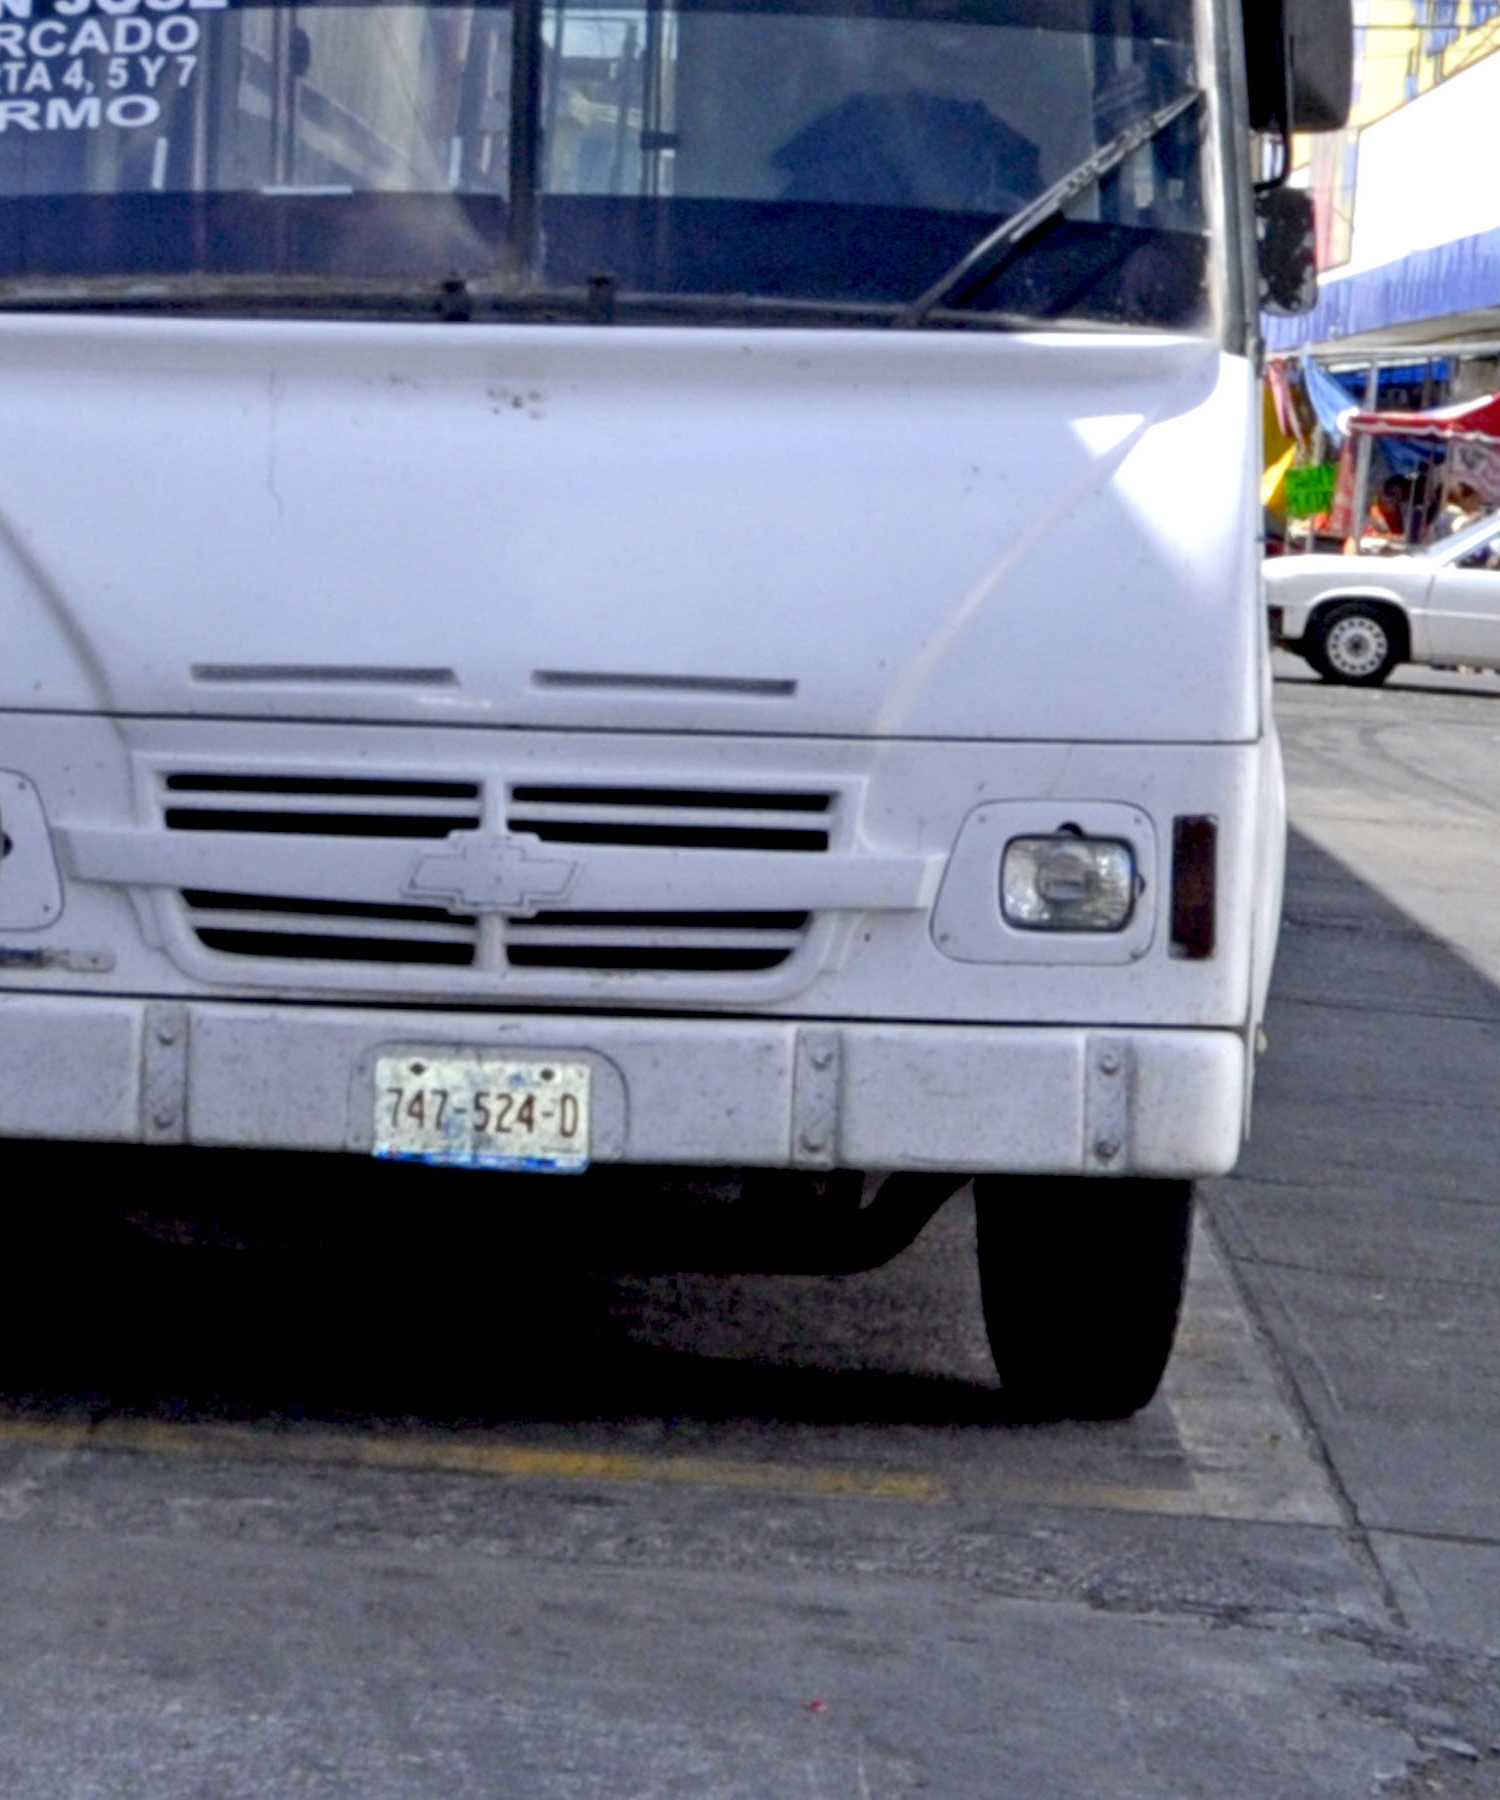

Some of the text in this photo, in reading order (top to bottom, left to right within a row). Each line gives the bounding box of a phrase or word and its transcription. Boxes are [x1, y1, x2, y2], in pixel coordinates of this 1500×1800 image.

[63, 57, 95, 95] 4,
[106, 58, 130, 90] 5
[140, 55, 166, 88] Y
[177, 53, 198, 87] 7
